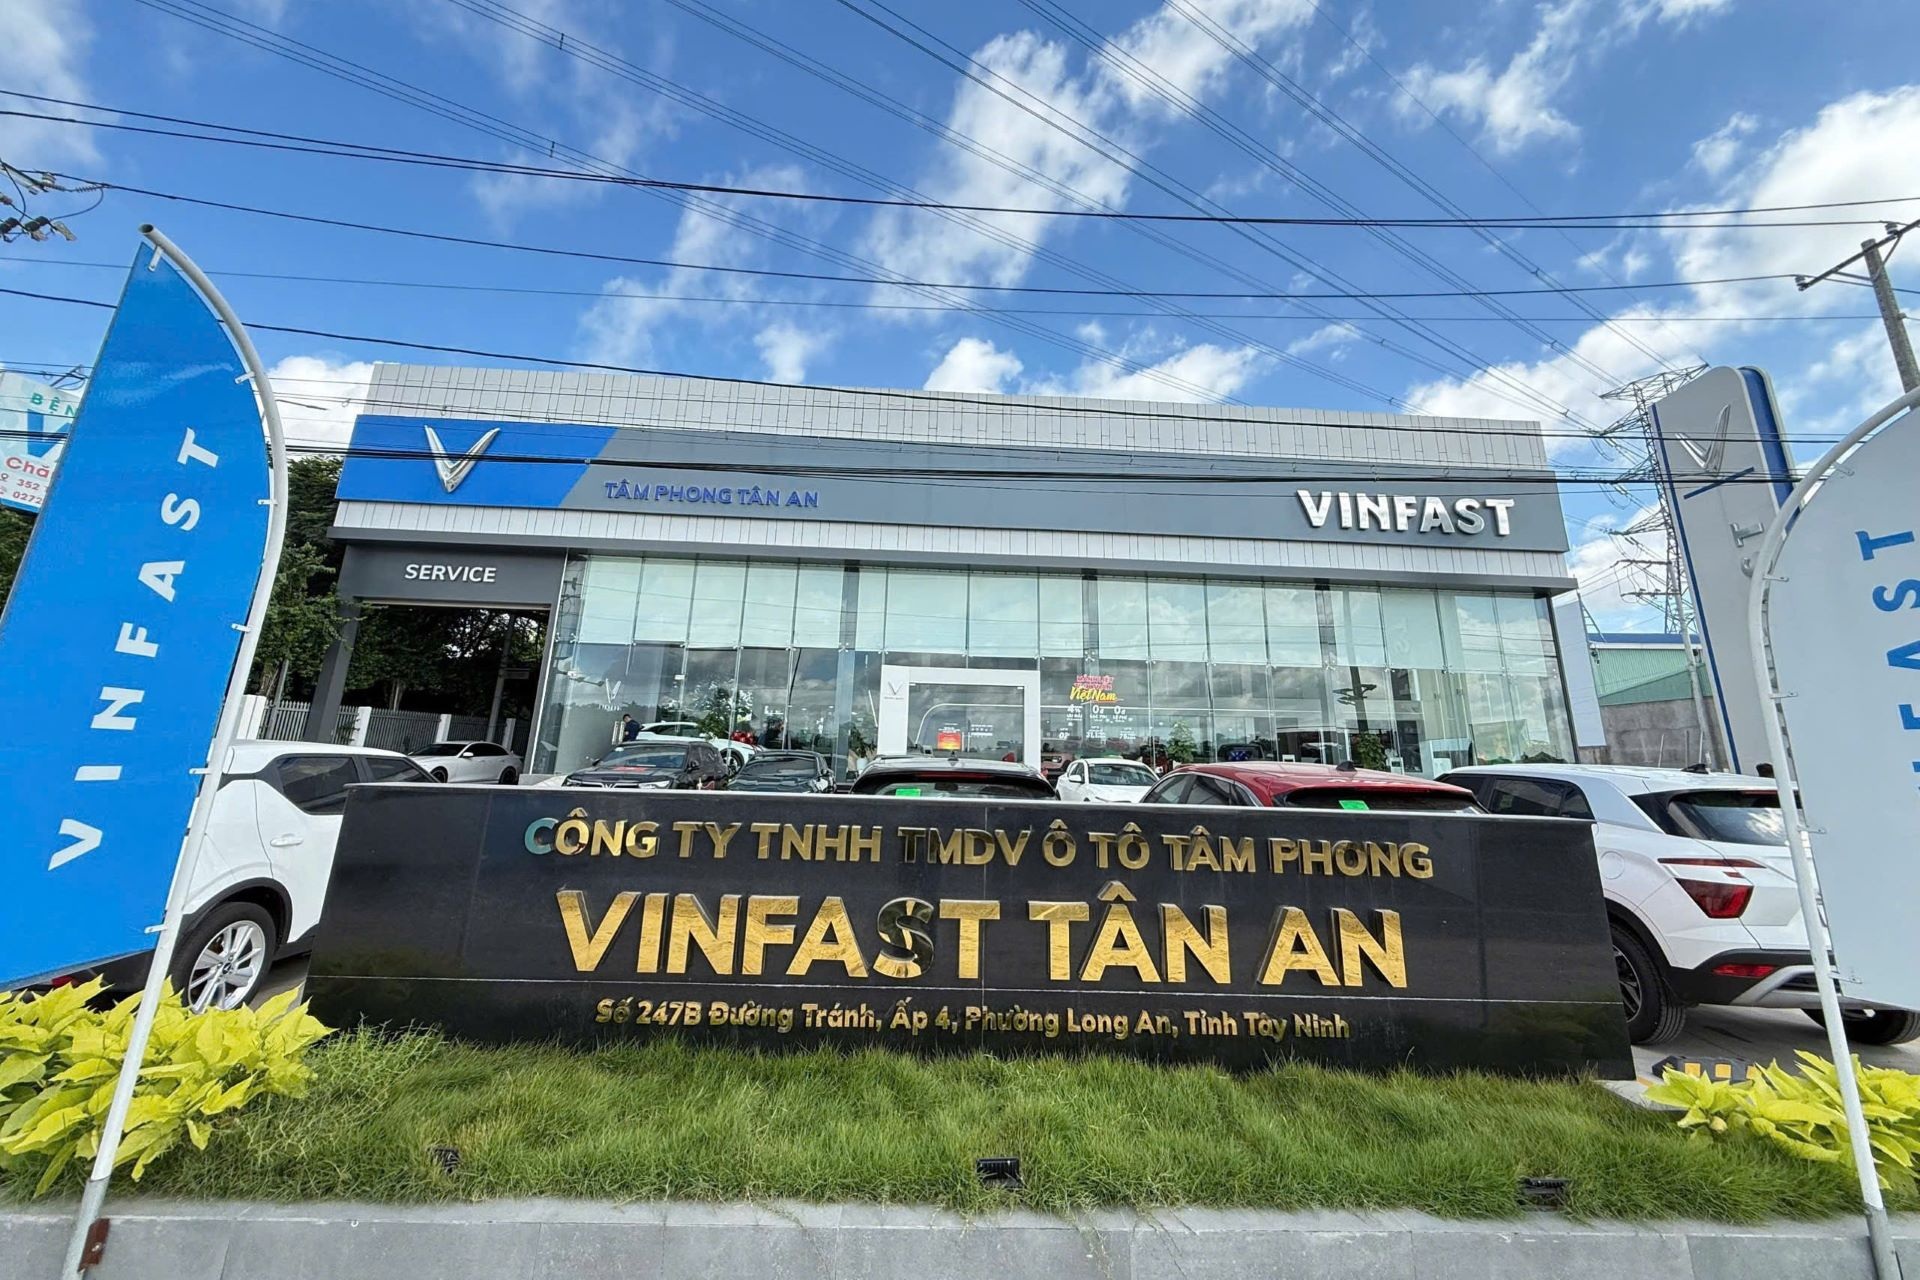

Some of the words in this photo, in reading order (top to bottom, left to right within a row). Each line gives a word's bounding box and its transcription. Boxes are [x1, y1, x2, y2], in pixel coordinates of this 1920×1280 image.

[17, 478, 40, 491] 352
[605, 478, 650, 502] TÂM
[655, 484, 732, 505] PHONG
[737, 483, 780, 507] TÂN
[785, 489, 819, 508] AN
[1296, 489, 1515, 536] VINFAST
[404, 563, 496, 584] SERVICE
[48, 427, 219, 871] VINFAST
[523, 807, 660, 858] CÔNG
[672, 822, 741, 859] TY
[750, 823, 883, 862] TNHH
[897, 826, 1032, 866] TMDV
[1042, 818, 1077, 867] Ô
[1088, 821, 1150, 870] TÔ
[1162, 825, 1256, 873] TÂM
[1269, 837, 1435, 879] PHONG
[556, 889, 1001, 979] VINFAST
[1028, 880, 1232, 984] TÂN
[1257, 905, 1408, 988] AN
[594, 996, 634, 1024] Số
[636, 1000, 701, 1026] 247B
[708, 997, 794, 1033] Đường
[800, 999, 882, 1032] Tránh,
[890, 996, 929, 1036] Ấp
[935, 1005, 958, 1034] 4,
[965, 1004, 1060, 1037] Phường
[1067, 1008, 1128, 1039] Long
[1134, 1009, 1178, 1038] An,
[1184, 1008, 1238, 1036] Tỉnh
[1243, 1012, 1287, 1042] Tây
[1293, 1012, 1350, 1039] Ninh
